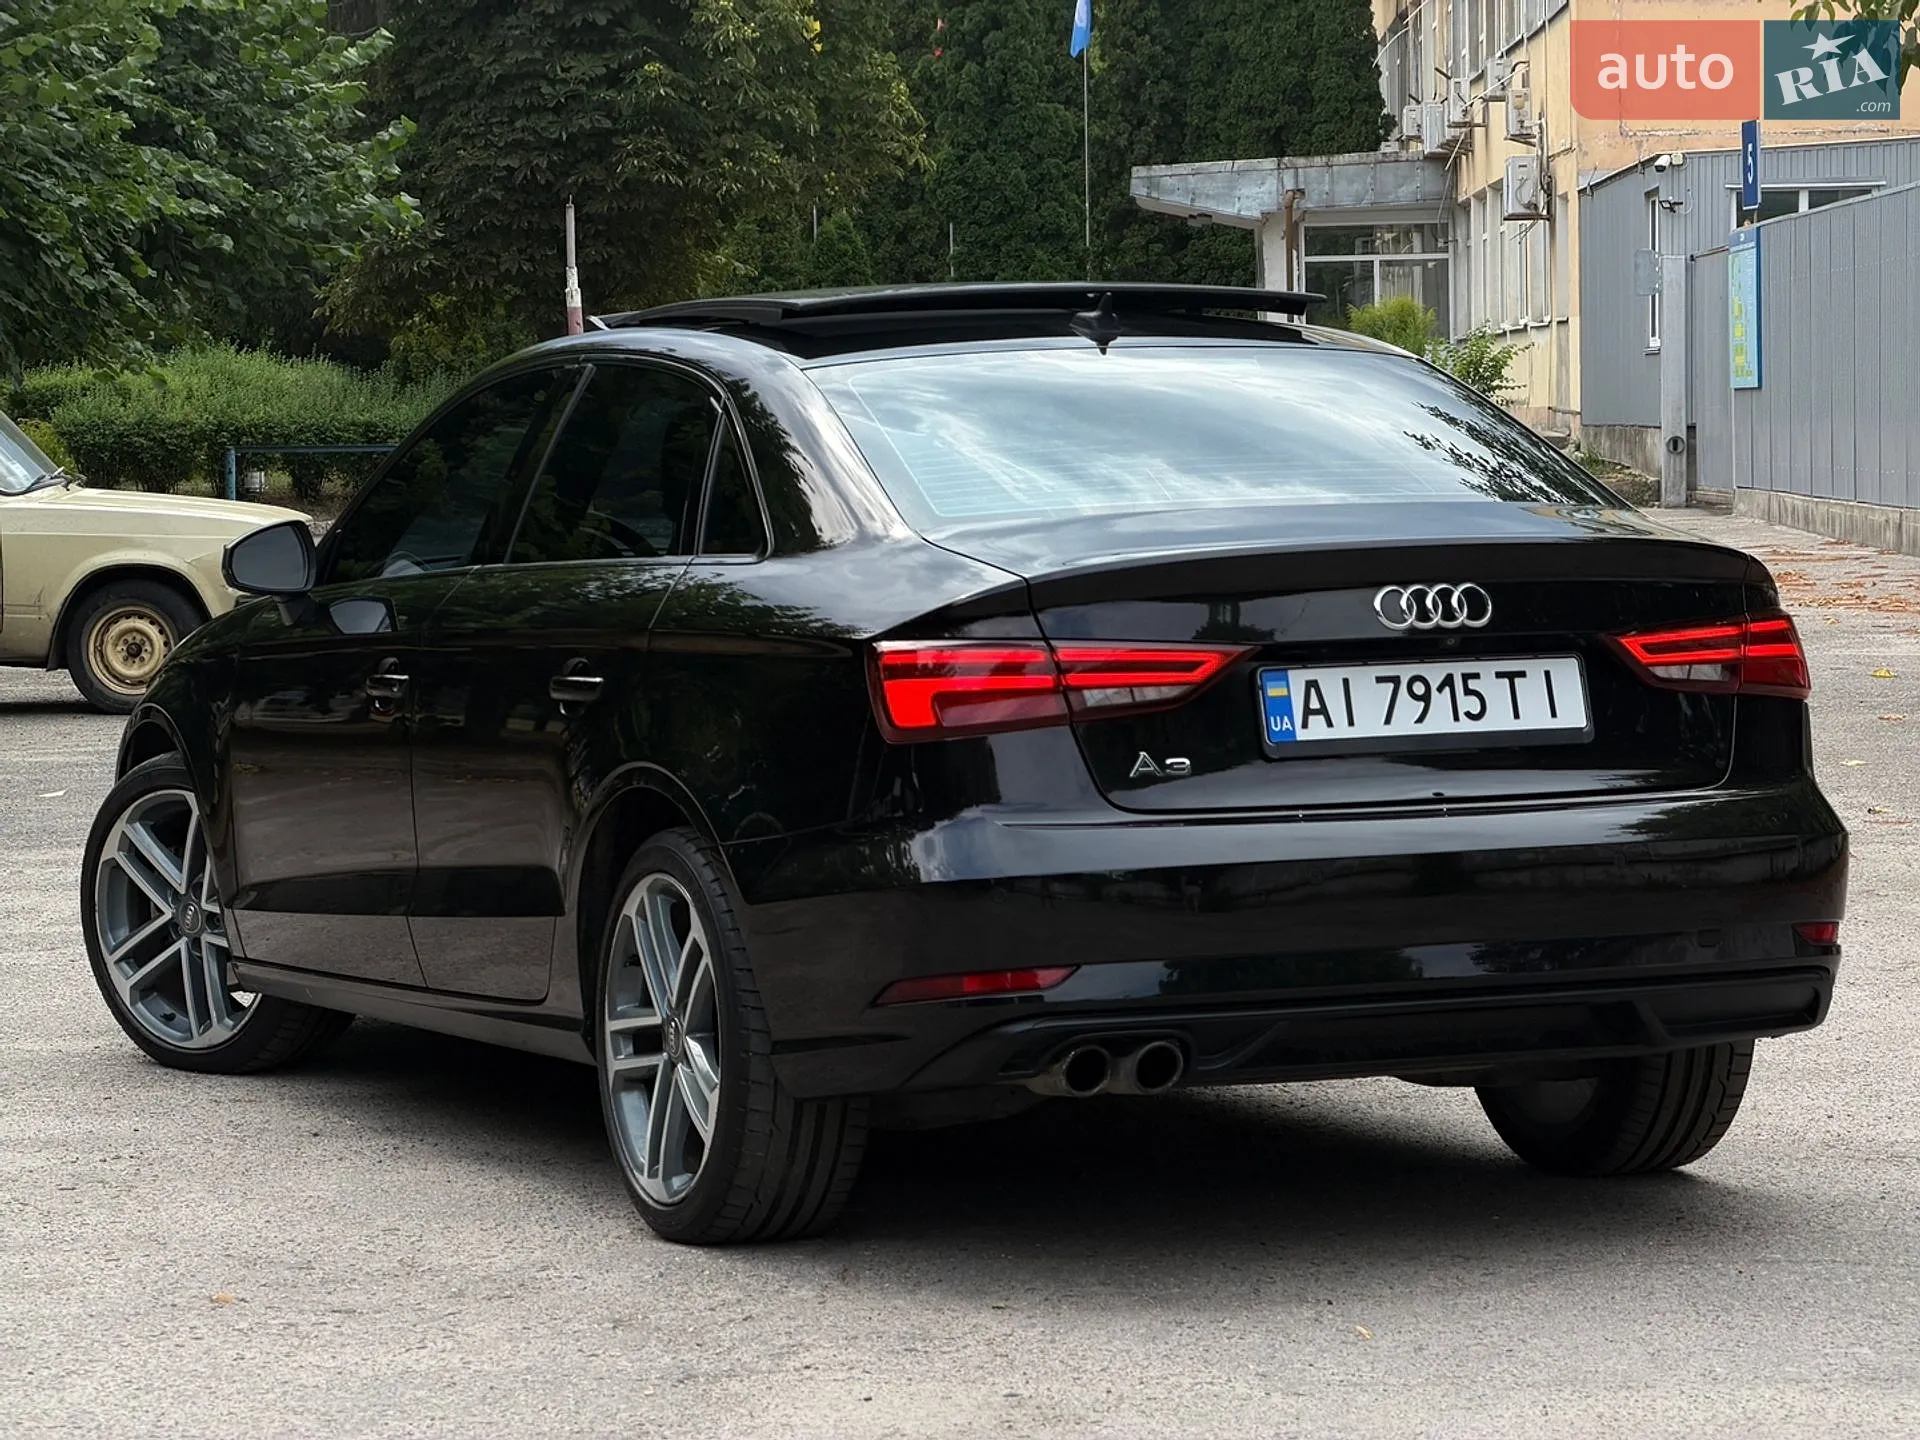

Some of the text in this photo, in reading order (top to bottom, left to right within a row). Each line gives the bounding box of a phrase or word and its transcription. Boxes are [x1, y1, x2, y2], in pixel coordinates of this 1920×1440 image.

[1747, 142, 1754, 184] 5
[1301, 669, 1558, 729] AI 7915 TI
[1270, 715, 1293, 732] UA
[1129, 751, 1191, 778] A3
